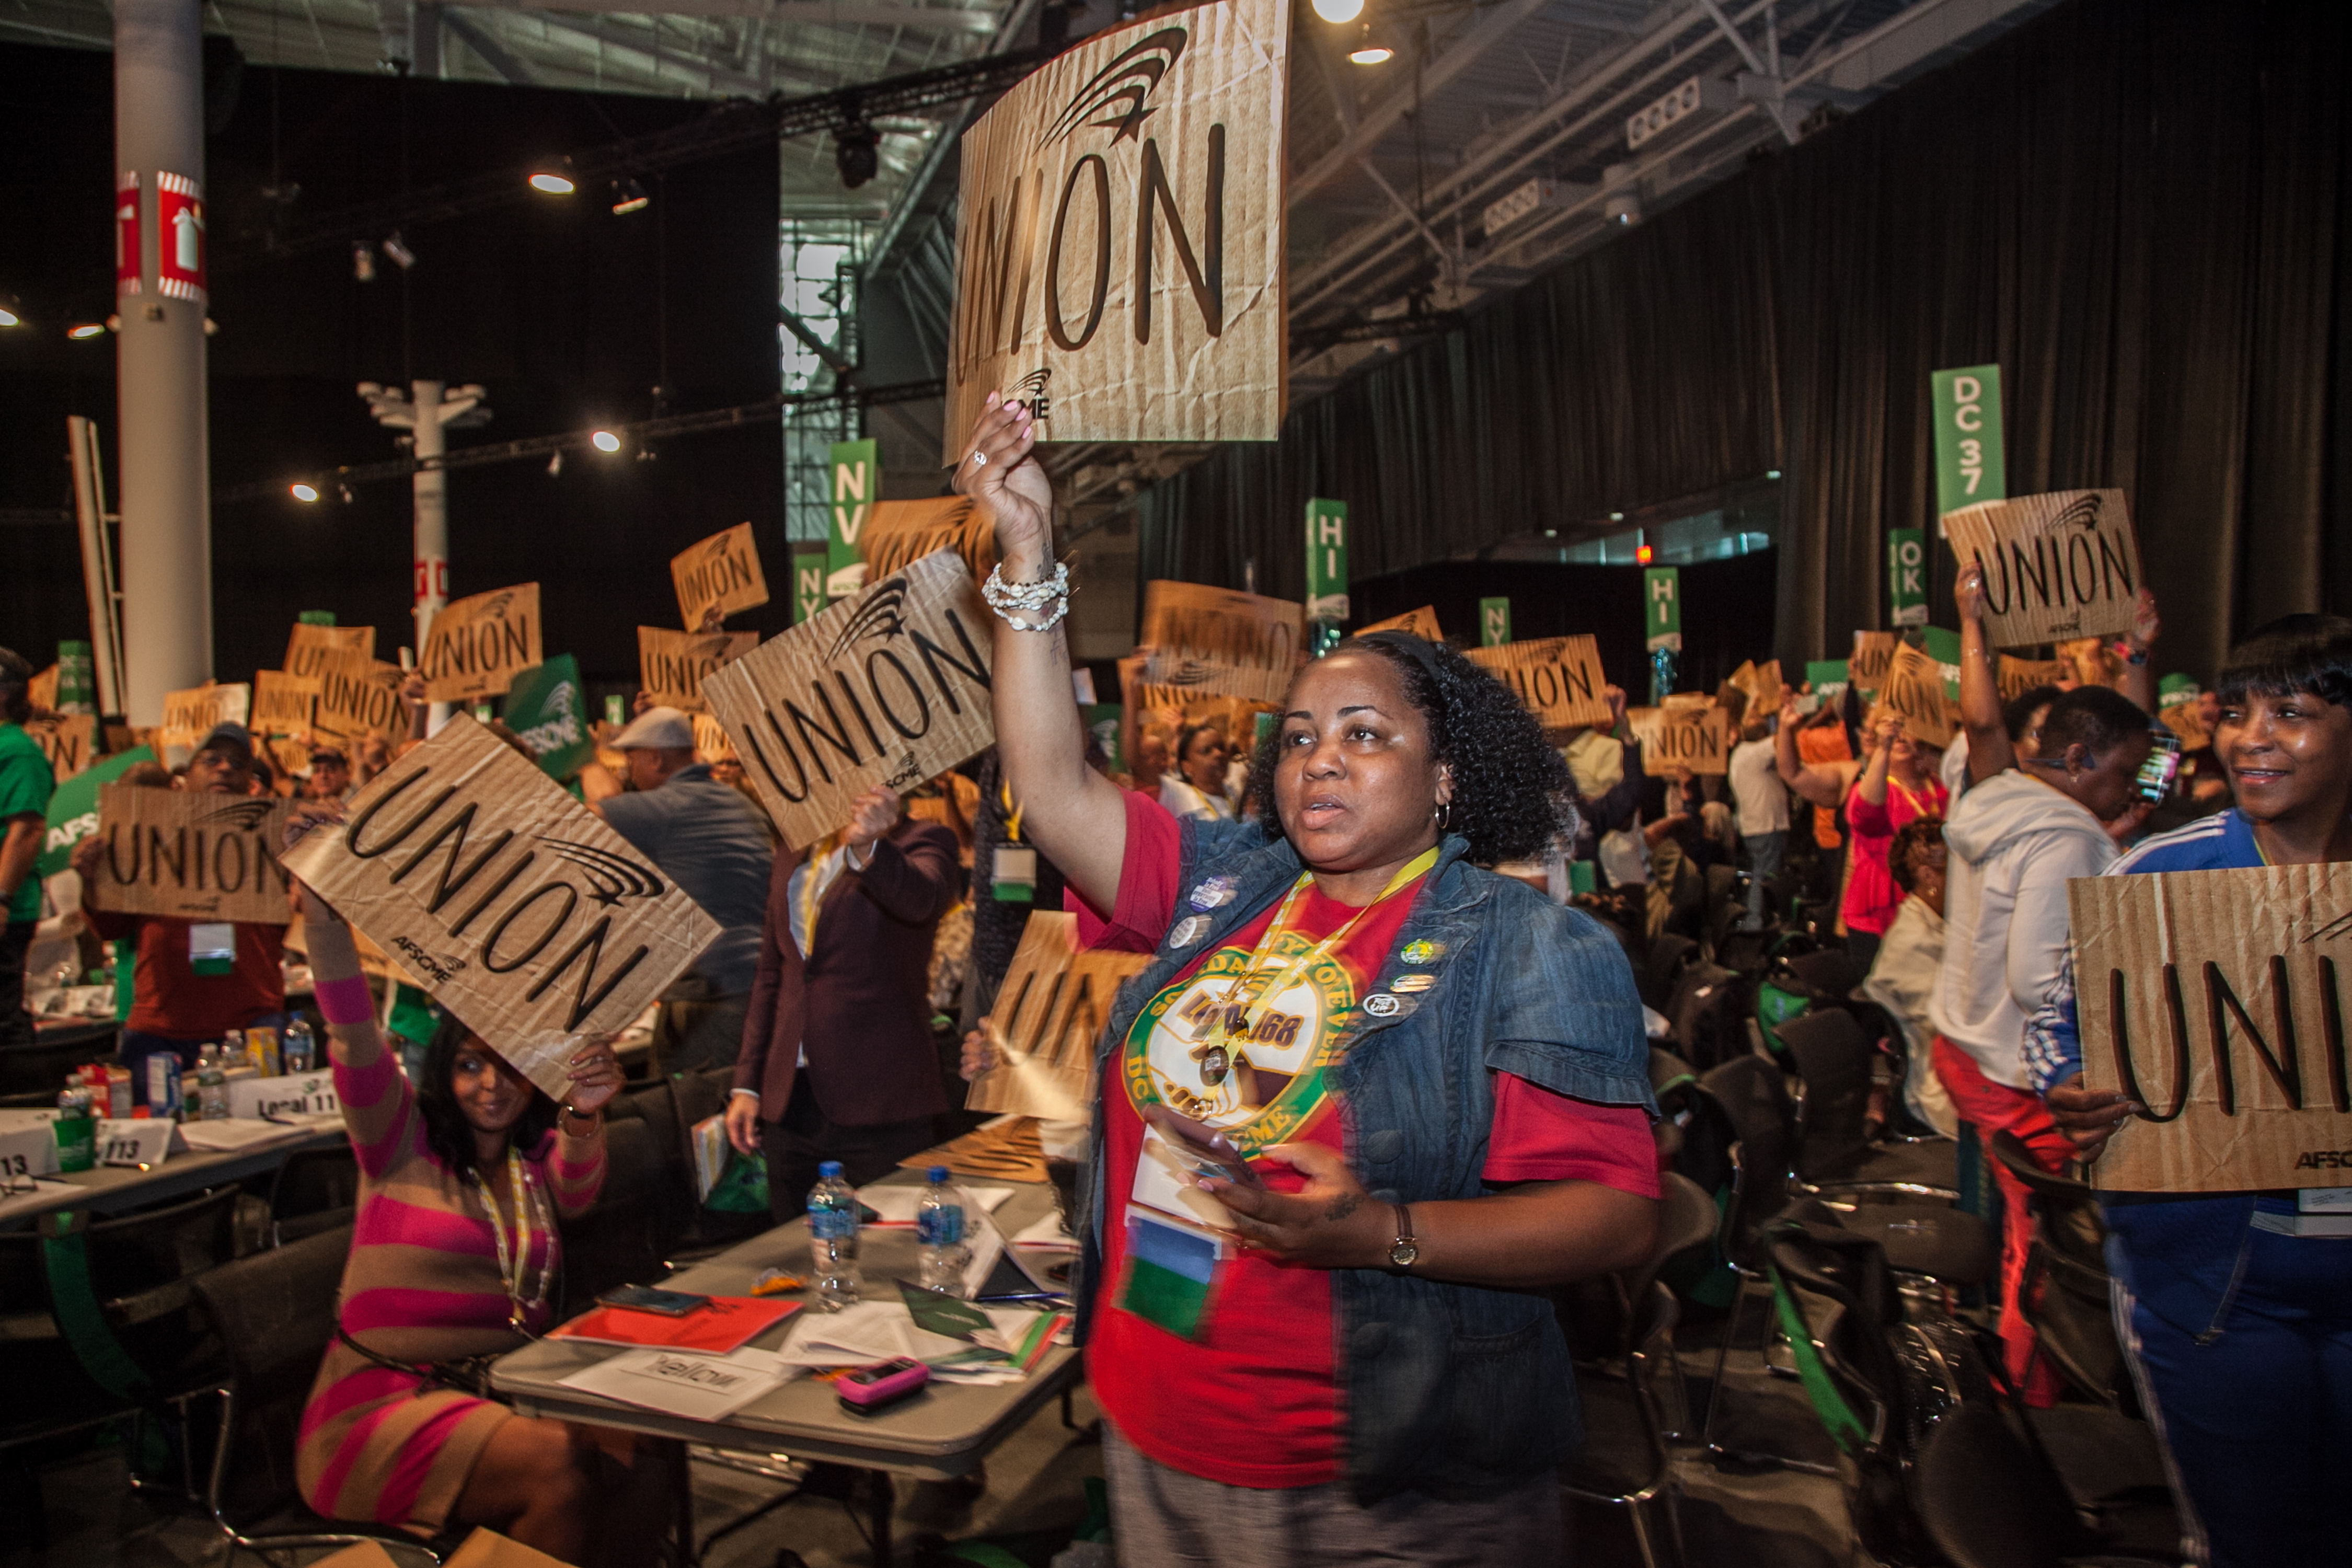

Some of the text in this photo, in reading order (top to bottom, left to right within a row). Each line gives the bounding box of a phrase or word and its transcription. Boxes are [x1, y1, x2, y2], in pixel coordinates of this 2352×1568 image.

[955, 123, 1226, 387] UNION
[1954, 375, 1983, 495] DC 37
[835, 460, 866, 545] NV
[1319, 514, 1343, 579] HI
[1899, 540, 1922, 593] OK
[1973, 527, 2136, 615] UNION
[680, 547, 754, 616] UNION
[800, 568, 821, 618] NY
[1652, 578, 1674, 624] HI
[420, 614, 528, 682] UNION
[1486, 607, 1505, 647] NY
[742, 608, 991, 803] UNION
[1505, 660, 1594, 709] ION
[1648, 725, 1718, 759] NION
[882, 763, 921, 789] SCME
[45, 812, 100, 854] AFS
[107, 823, 291, 895] UNION
[345, 766, 649, 1033] UNION
[390, 935, 452, 984] AFSCME
[1127, 1056, 1149, 1100] DC
